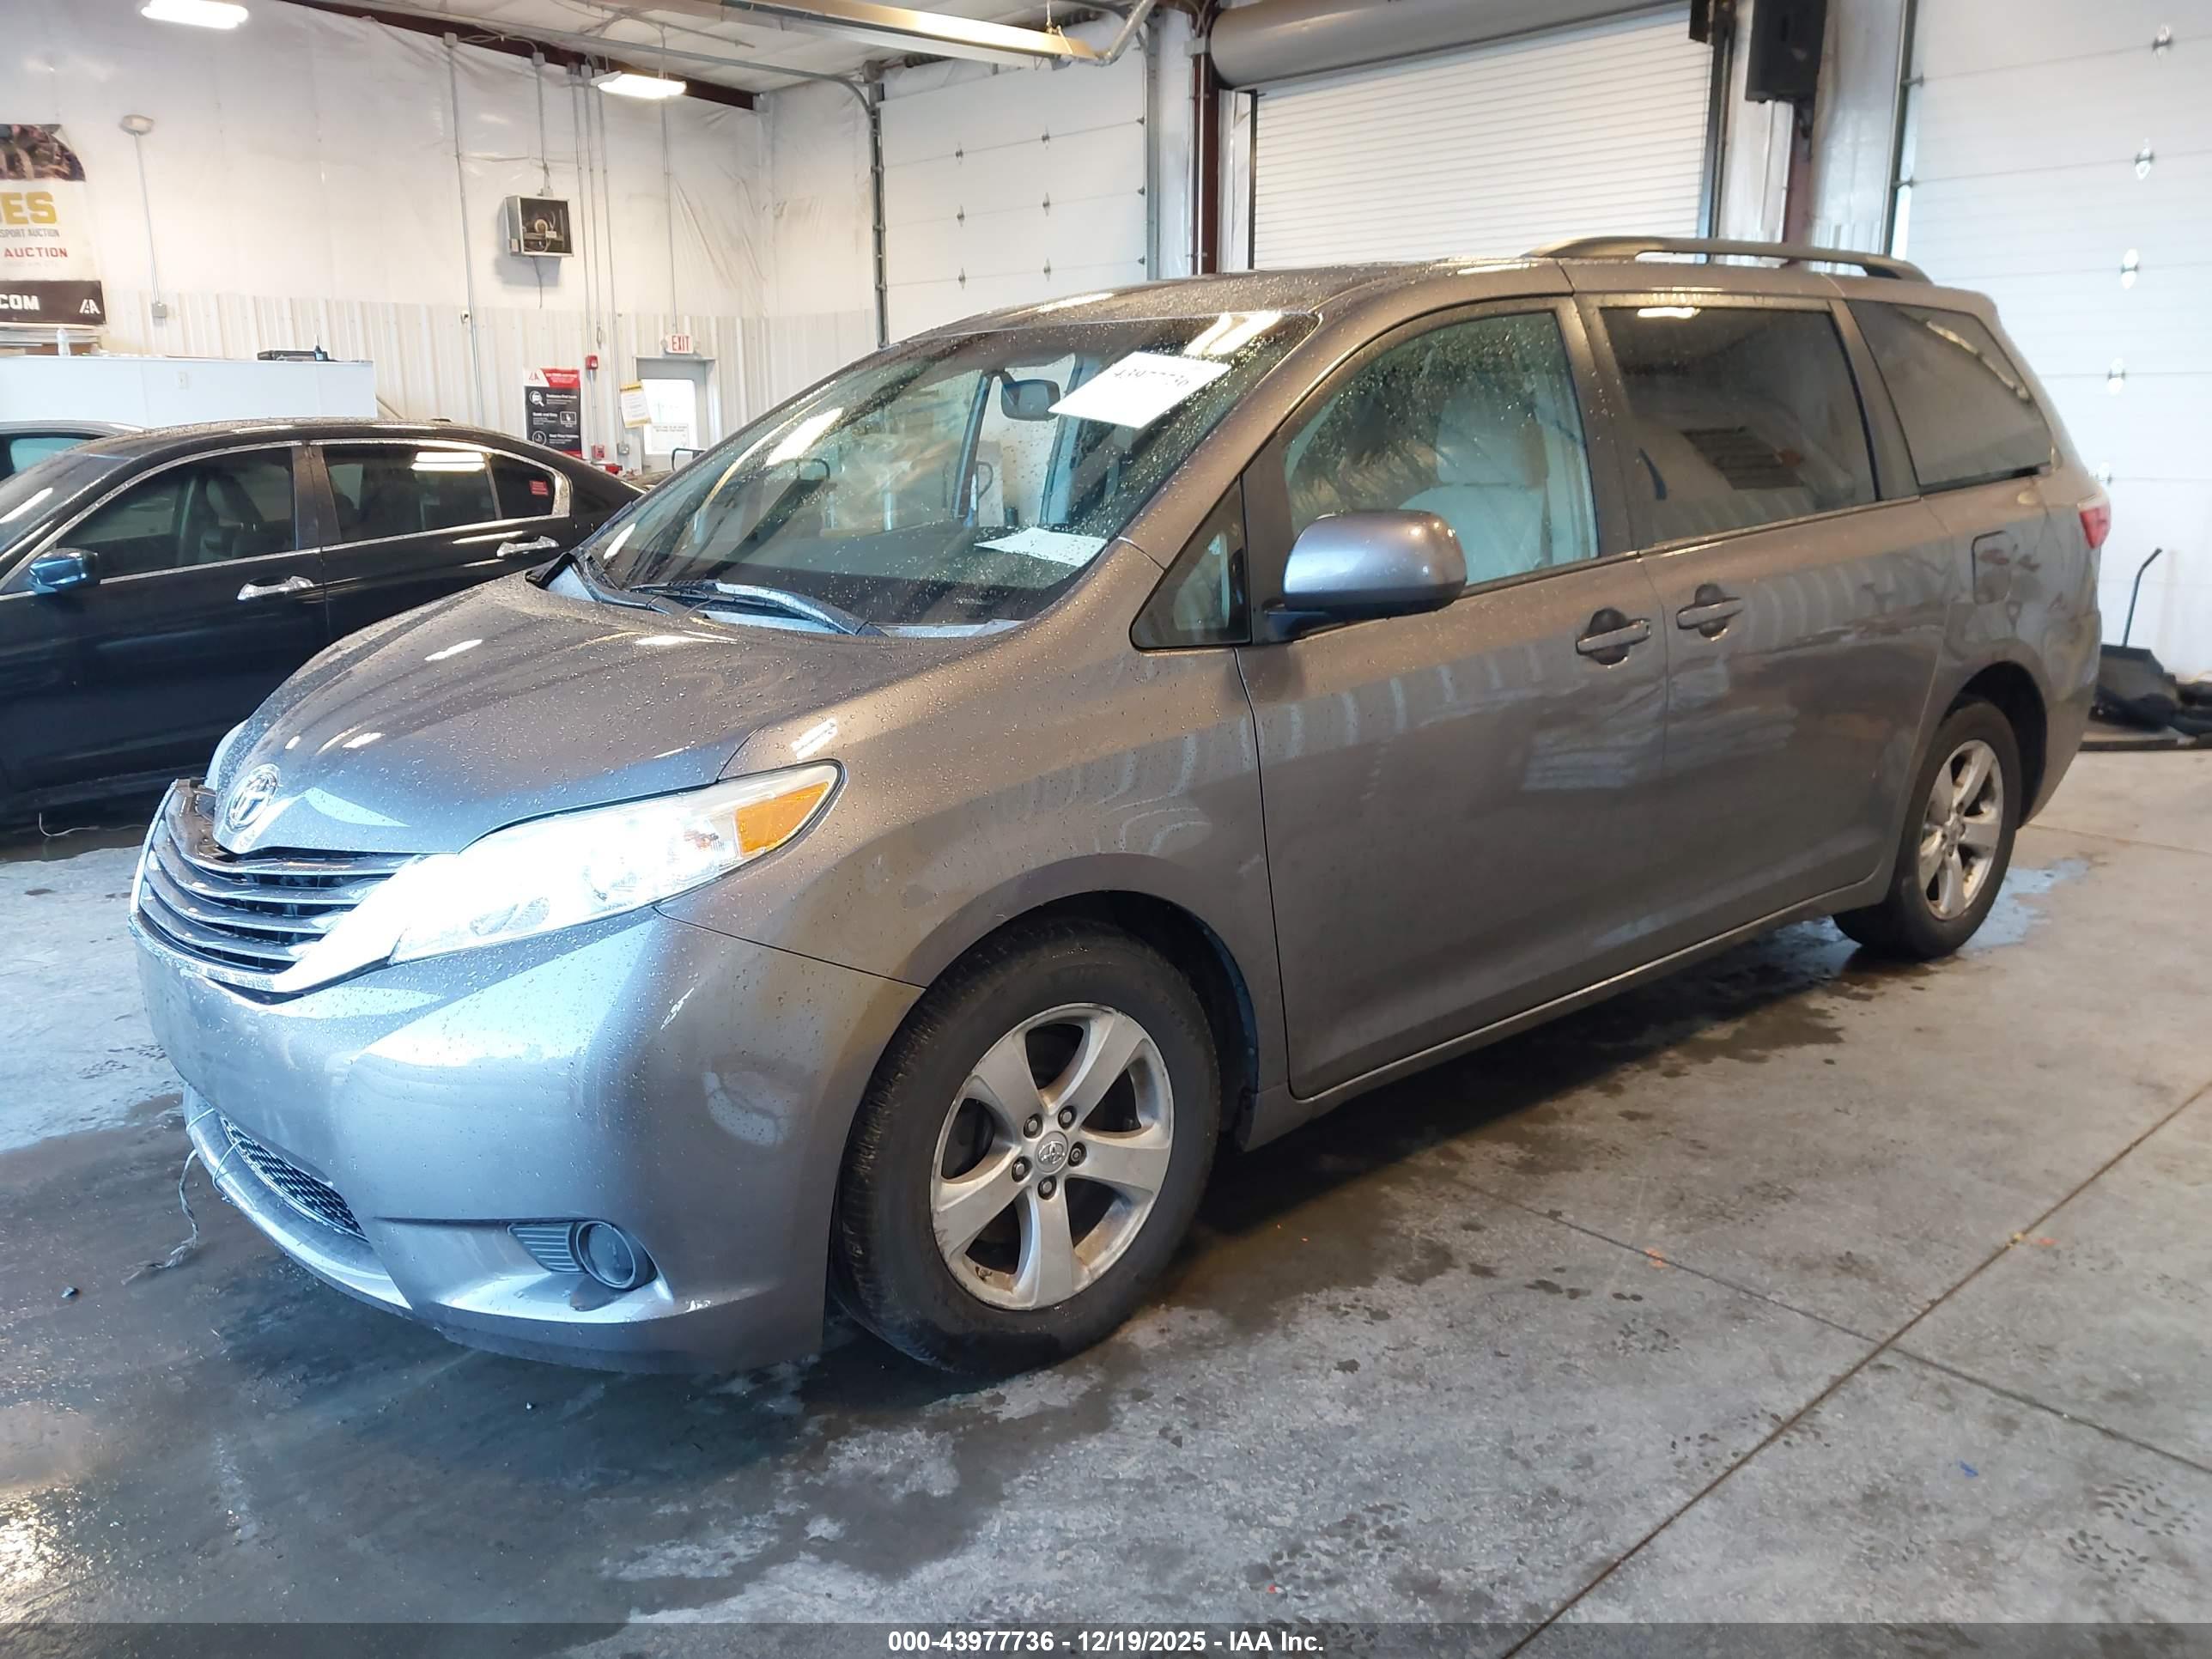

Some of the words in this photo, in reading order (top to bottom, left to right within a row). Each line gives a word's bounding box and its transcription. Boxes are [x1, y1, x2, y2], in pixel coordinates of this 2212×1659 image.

[0, 191, 57, 225] ES
[28, 228, 60, 237] AUCTION
[4, 247, 68, 258] AUCTION
[672, 335, 690, 351] EXIT
